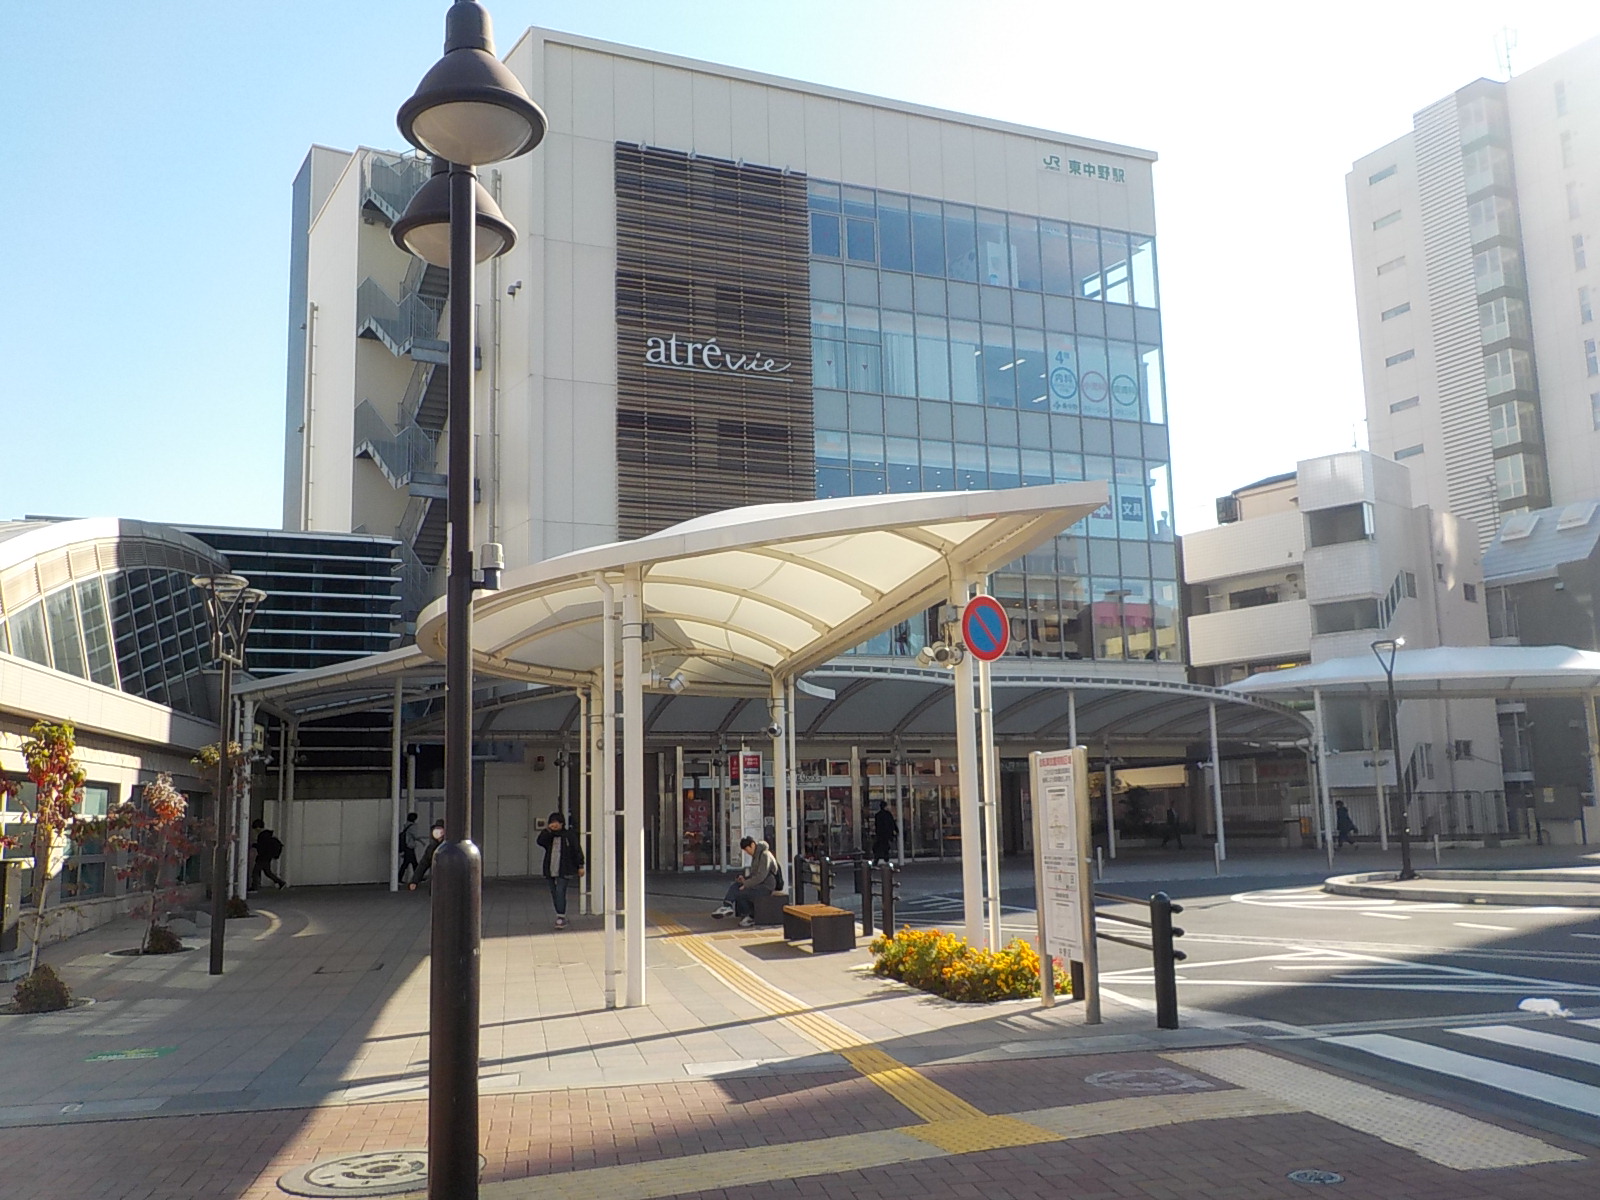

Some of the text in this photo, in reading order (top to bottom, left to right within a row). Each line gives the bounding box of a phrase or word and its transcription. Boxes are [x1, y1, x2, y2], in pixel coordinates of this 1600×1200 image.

[1043, 155, 1125, 183] JR 東中野駅
[1122, 502, 1142, 516] 文具
